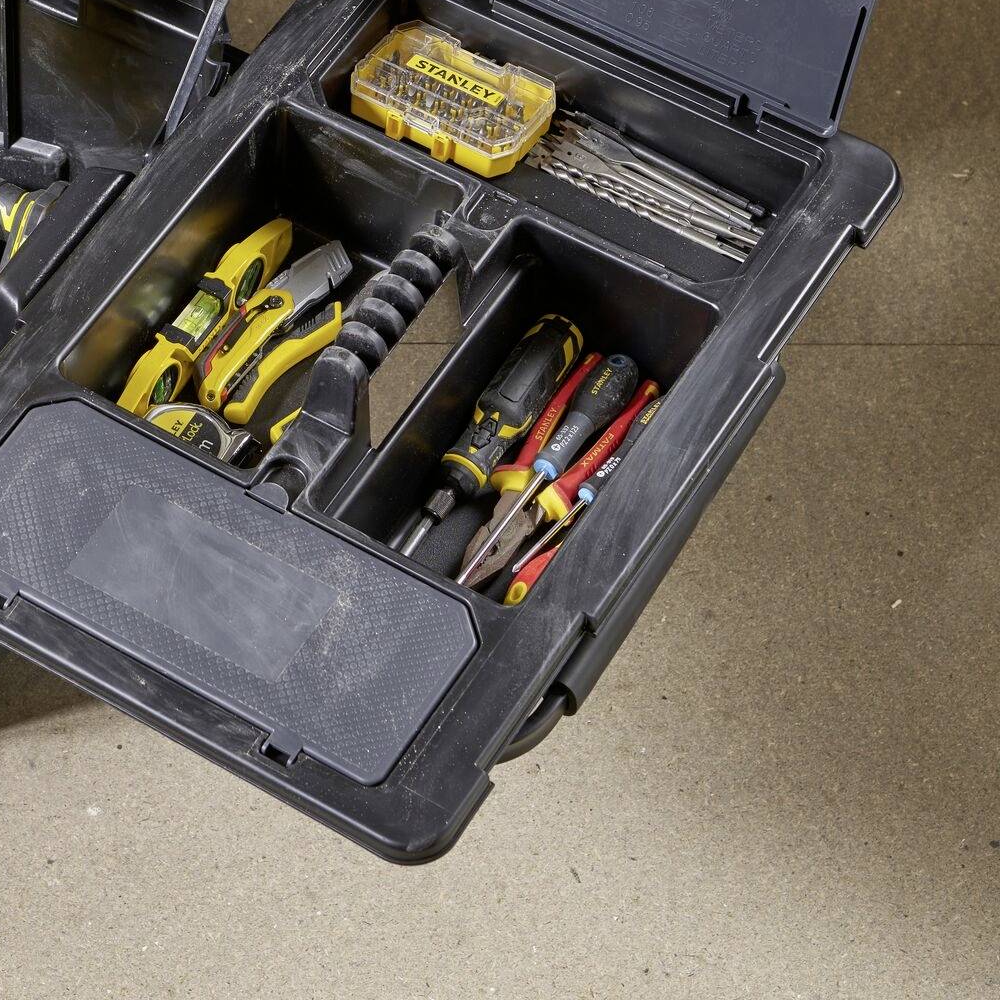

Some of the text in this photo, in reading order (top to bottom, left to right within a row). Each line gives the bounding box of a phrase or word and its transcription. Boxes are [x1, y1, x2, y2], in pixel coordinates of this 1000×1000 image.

[415, 60, 496, 99] STANLEY
[591, 367, 613, 395] STANLEY
[534, 406, 558, 441] STANLEY
[580, 433, 615, 467] FATMAX
